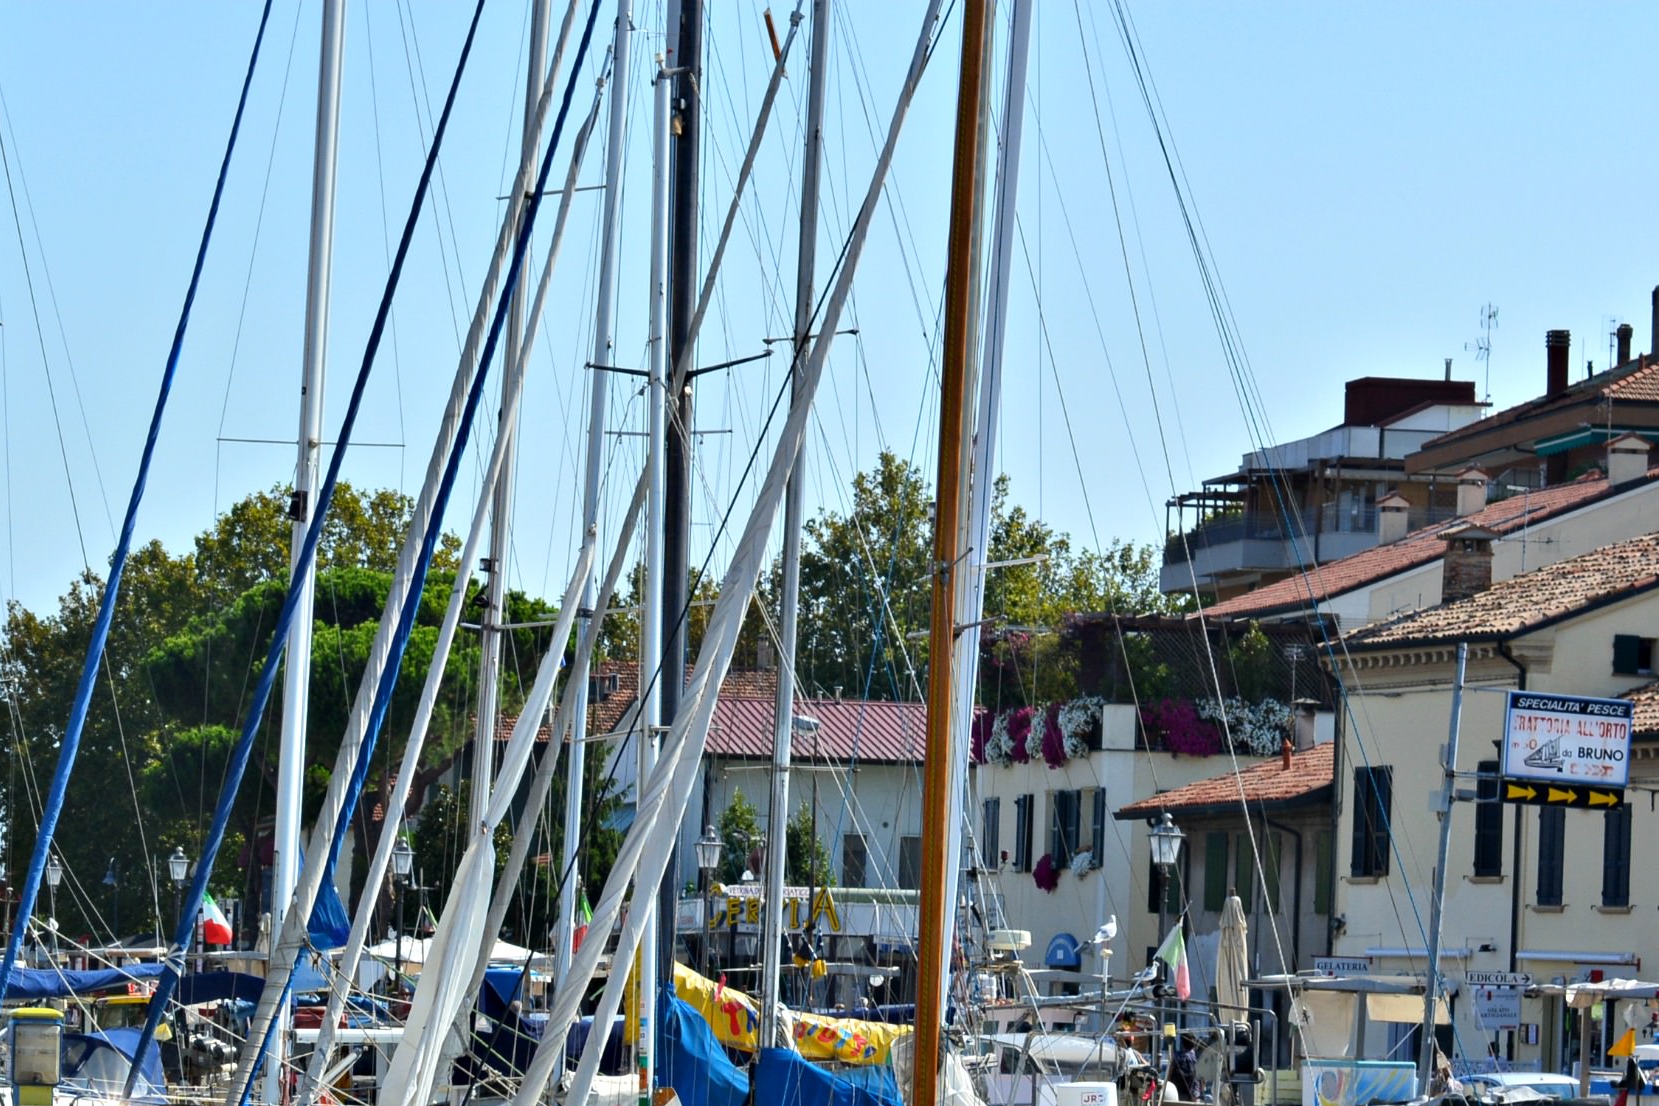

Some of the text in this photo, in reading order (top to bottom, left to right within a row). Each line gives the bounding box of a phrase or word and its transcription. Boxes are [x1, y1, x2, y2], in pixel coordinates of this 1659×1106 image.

[1518, 697, 1626, 716] SPECIALITA' PESCE
[1562, 746, 1624, 762] da BRUNO
[709, 883, 840, 932] CERIA
[1316, 961, 1368, 972] GELATERIA
[1470, 974, 1518, 983] EDICOLA
